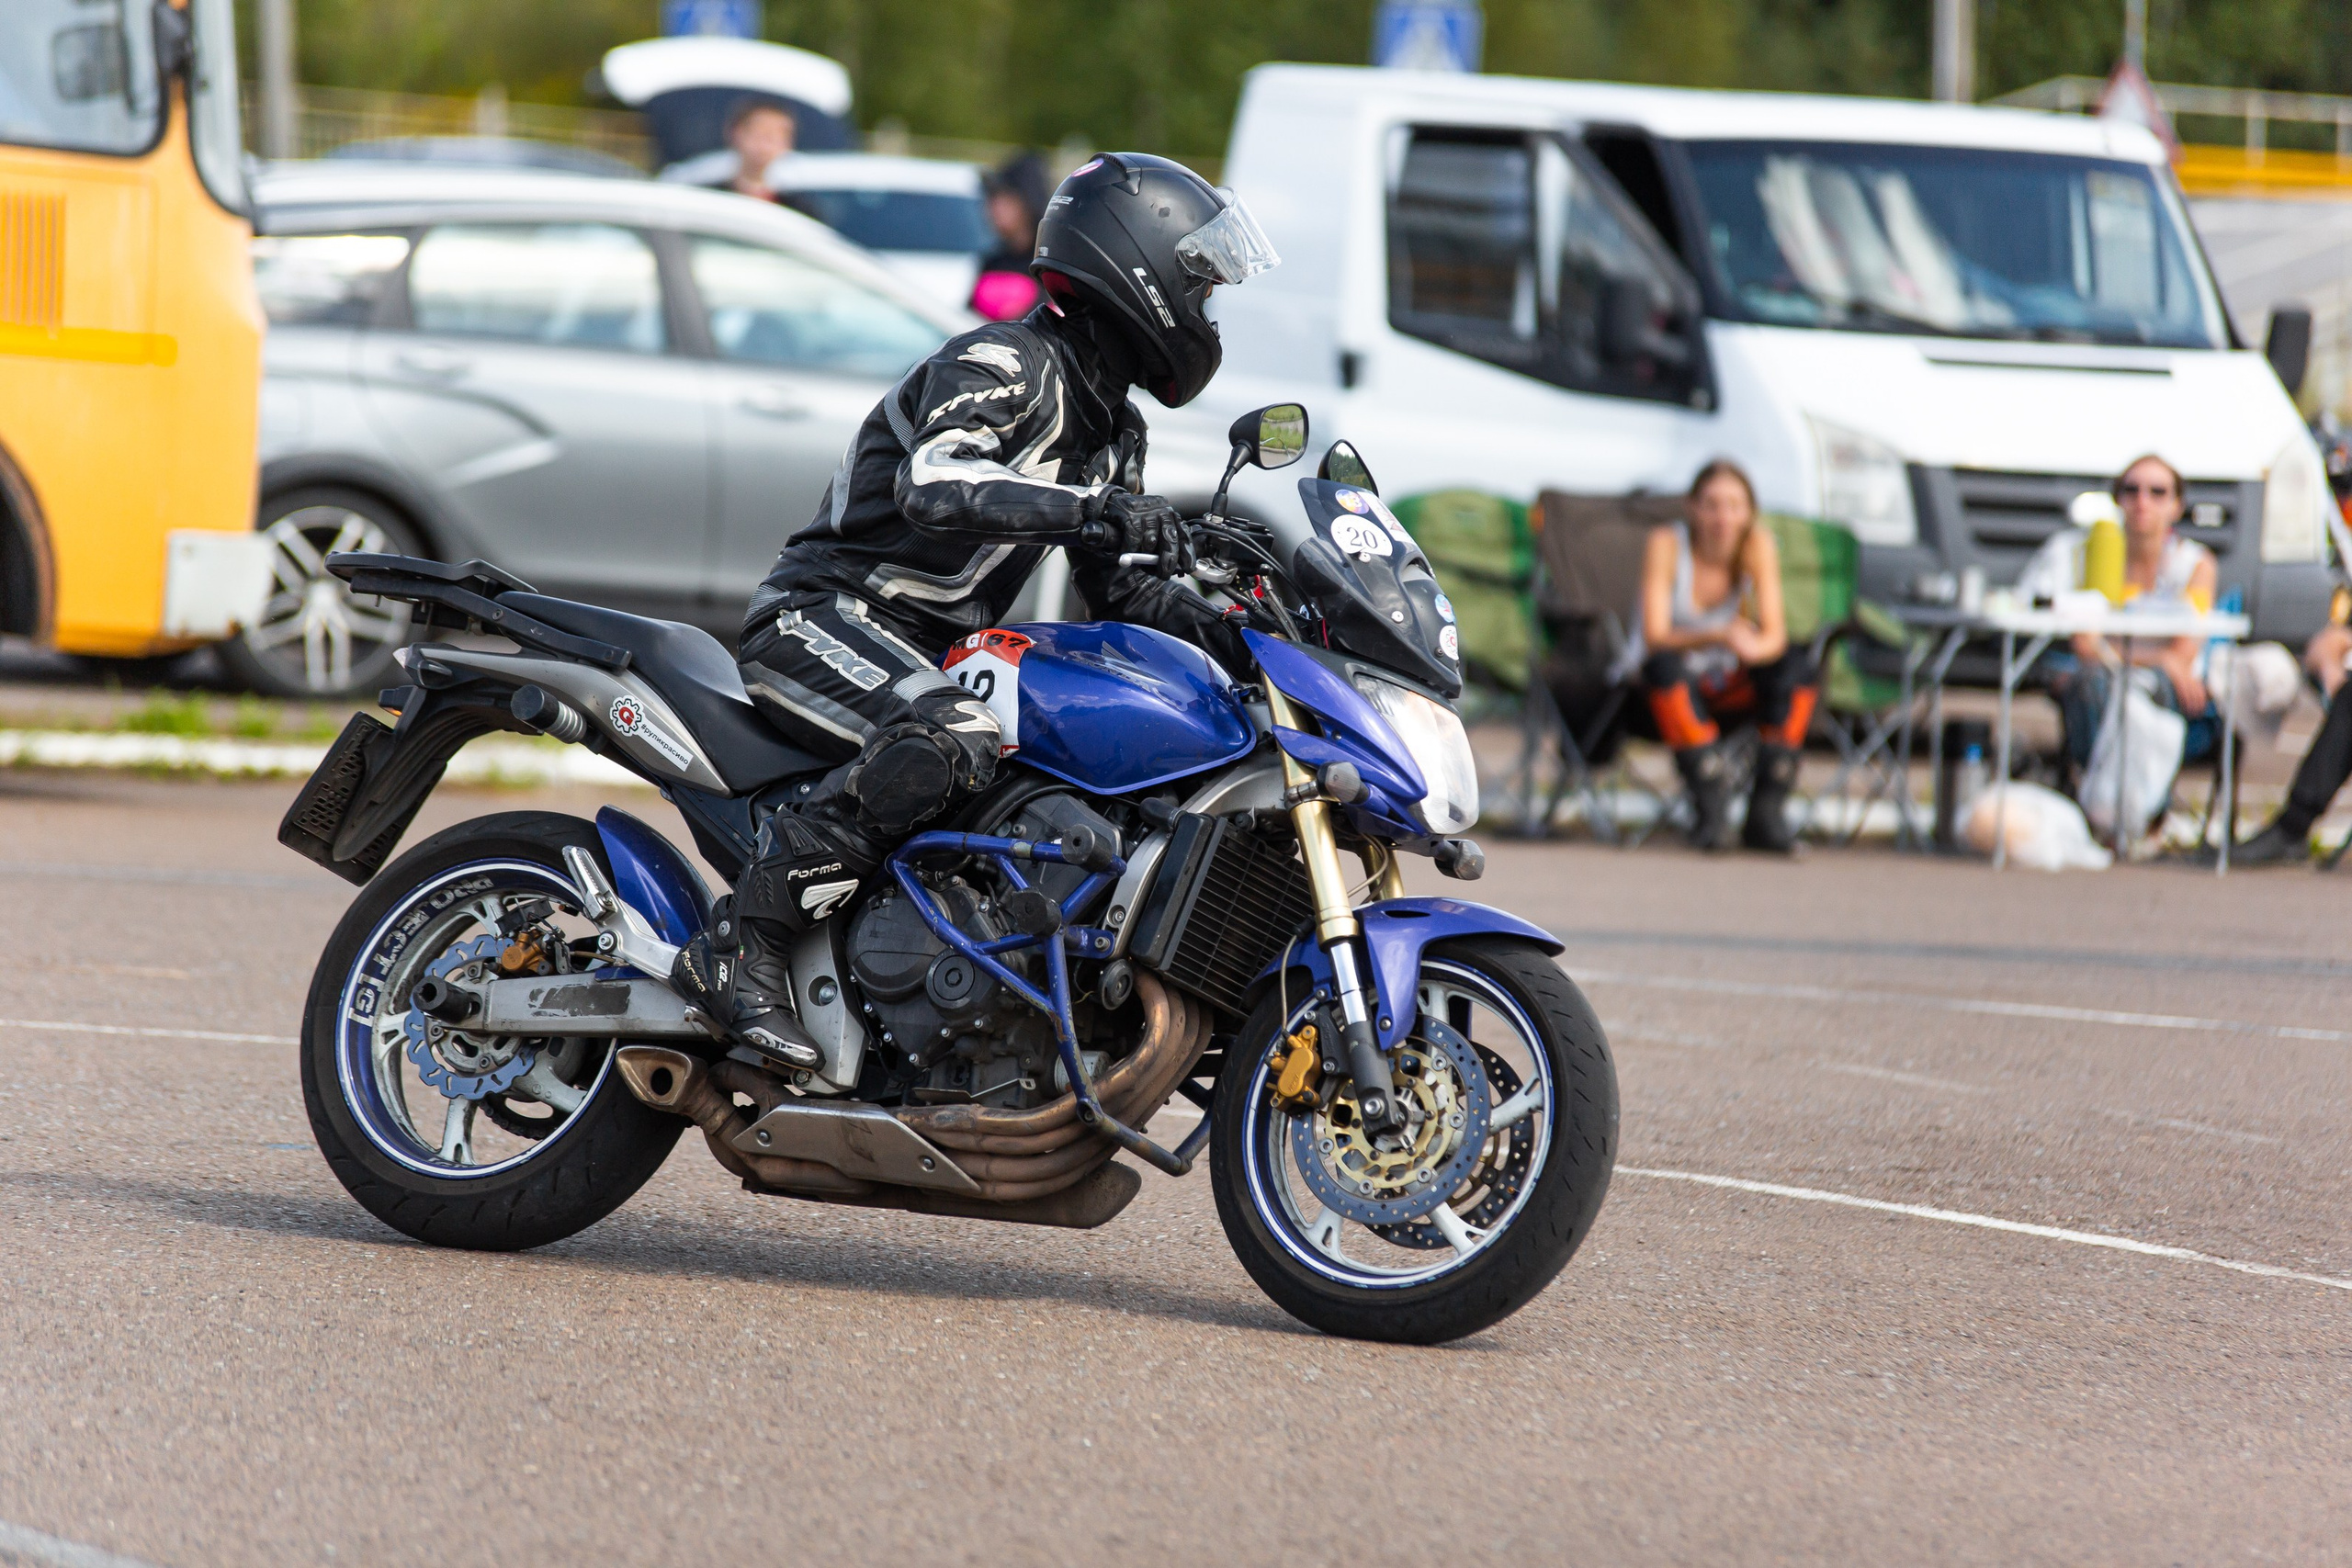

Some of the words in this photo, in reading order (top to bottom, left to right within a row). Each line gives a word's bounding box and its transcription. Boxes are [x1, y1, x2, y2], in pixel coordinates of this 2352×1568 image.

[1133, 267, 1176, 328] LS2
[1347, 527, 1378, 548] 20
[640, 724, 689, 765] #руликрасиво
